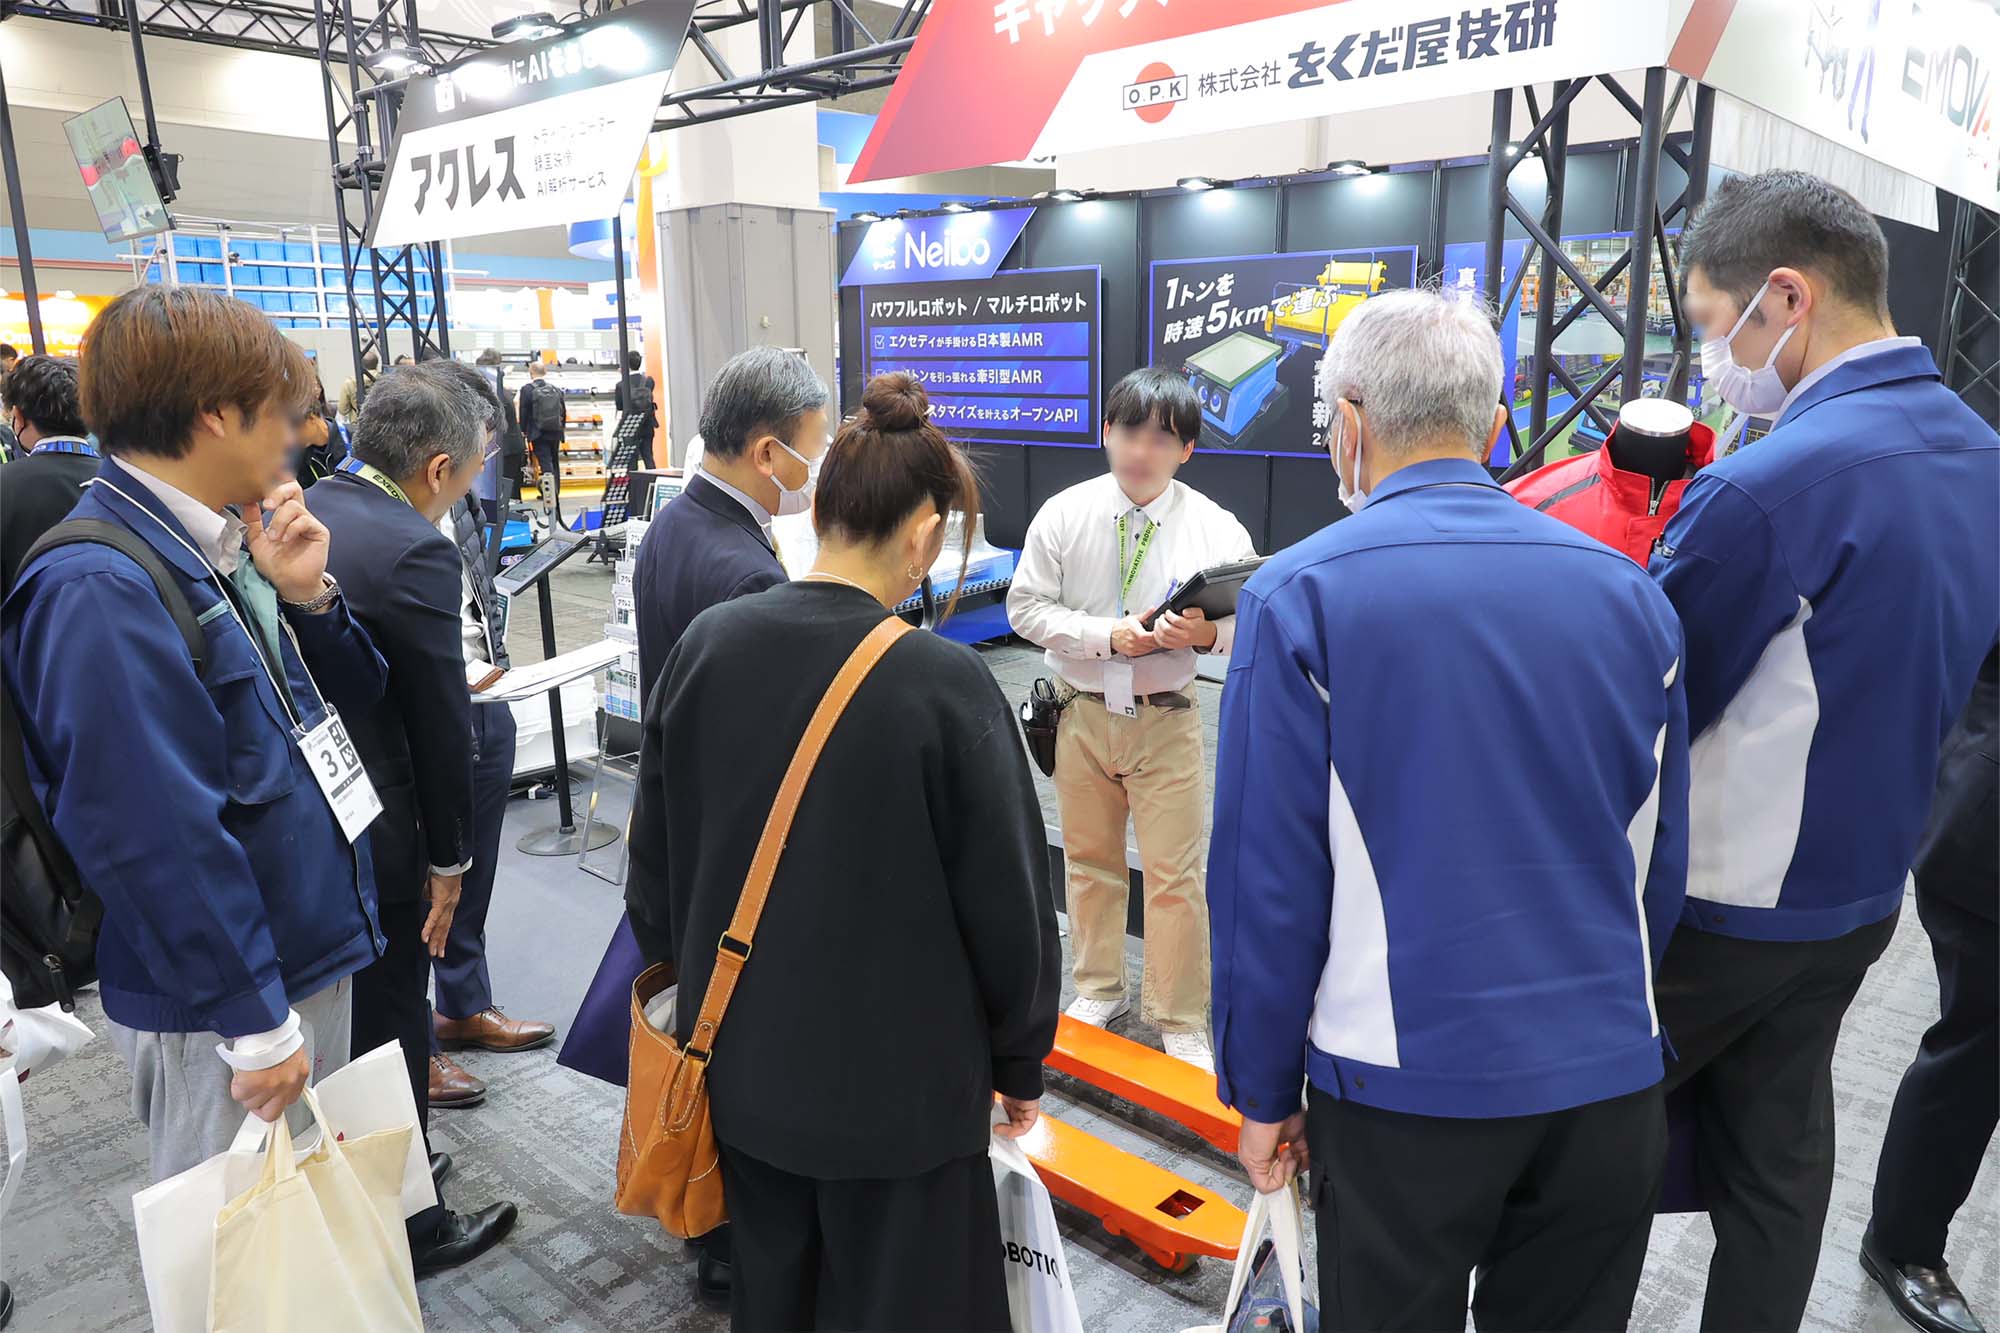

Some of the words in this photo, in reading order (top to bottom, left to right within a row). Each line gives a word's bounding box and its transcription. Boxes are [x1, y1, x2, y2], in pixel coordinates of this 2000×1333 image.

[1198, 60, 1281, 98] 株式会社
[1288, 0, 1557, 89] をくだ屋技研
[411, 136, 526, 215] アクレス
[870, 297, 967, 318] パワフルロボット
[987, 291, 1087, 315] マルチロボット
[1163, 284, 1341, 345] 時速5kmで運ぶ
[1166, 273, 1235, 310] 1トンを
[321, 750, 339, 778] 3
